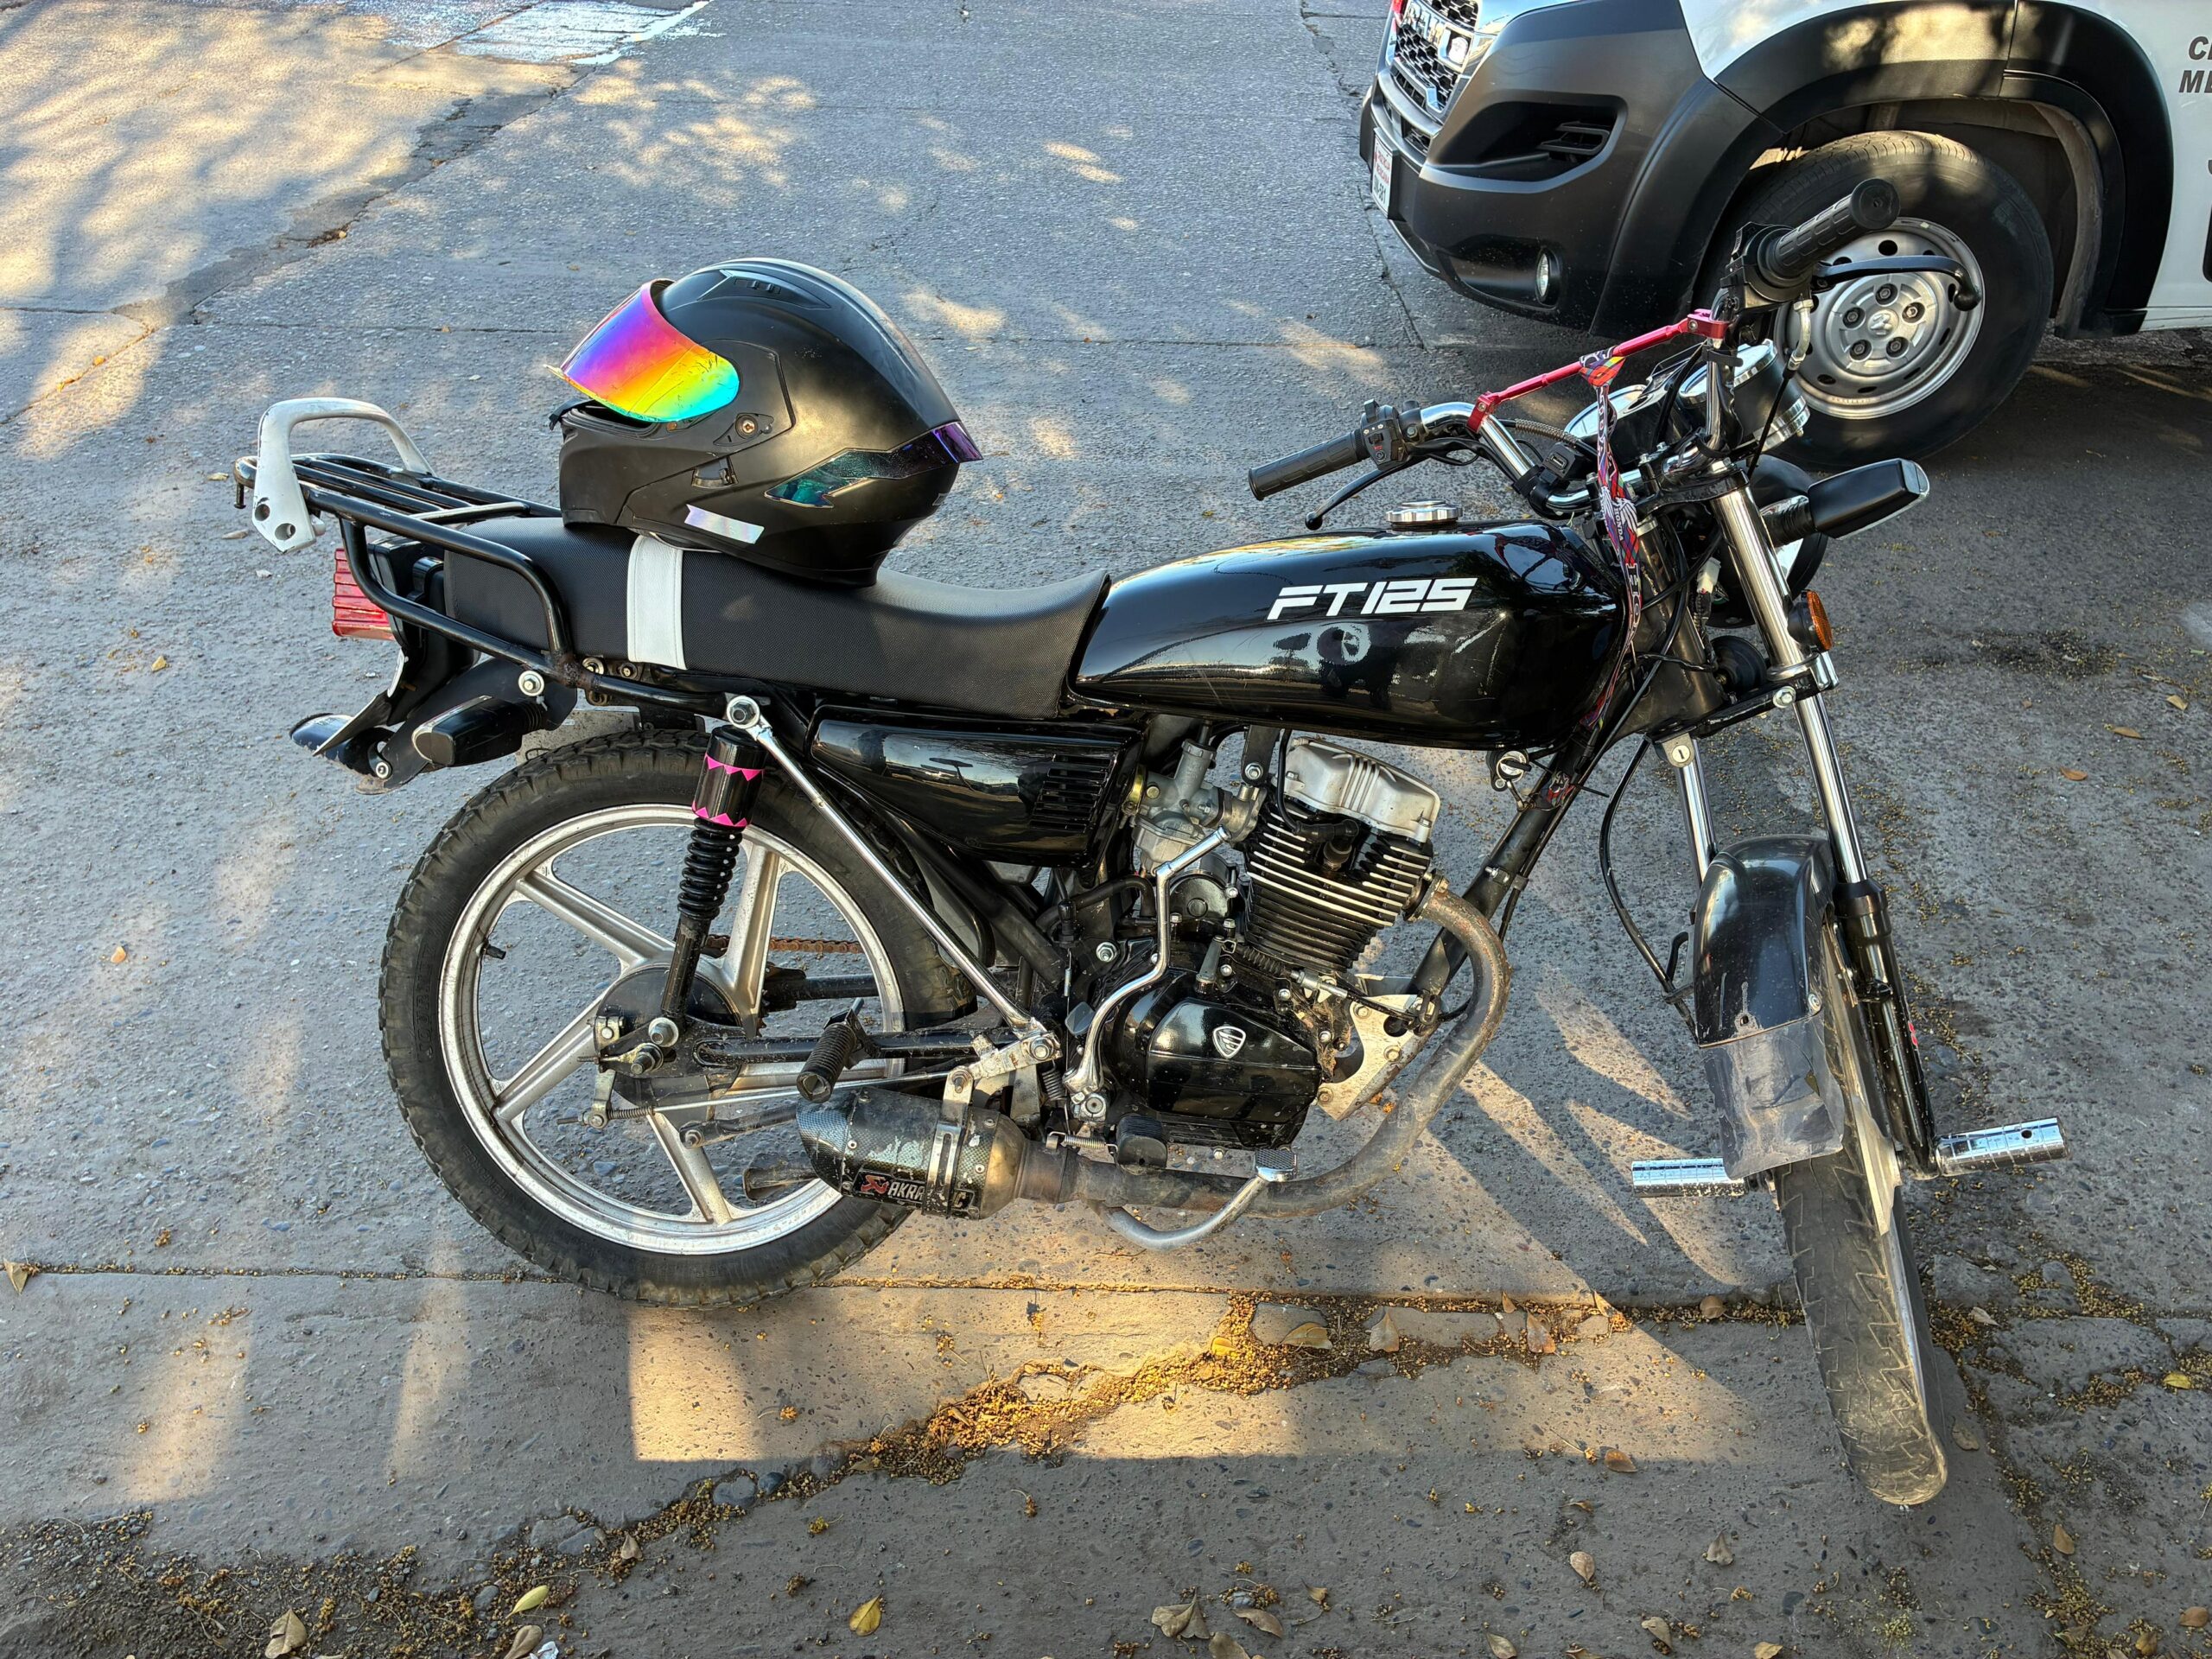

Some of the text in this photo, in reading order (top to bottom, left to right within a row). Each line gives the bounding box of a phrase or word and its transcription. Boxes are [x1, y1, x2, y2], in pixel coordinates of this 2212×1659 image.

[2189, 35, 2212, 60] C
[1613, 507, 1624, 542] HONDA
[1266, 577, 1478, 620] FT125
